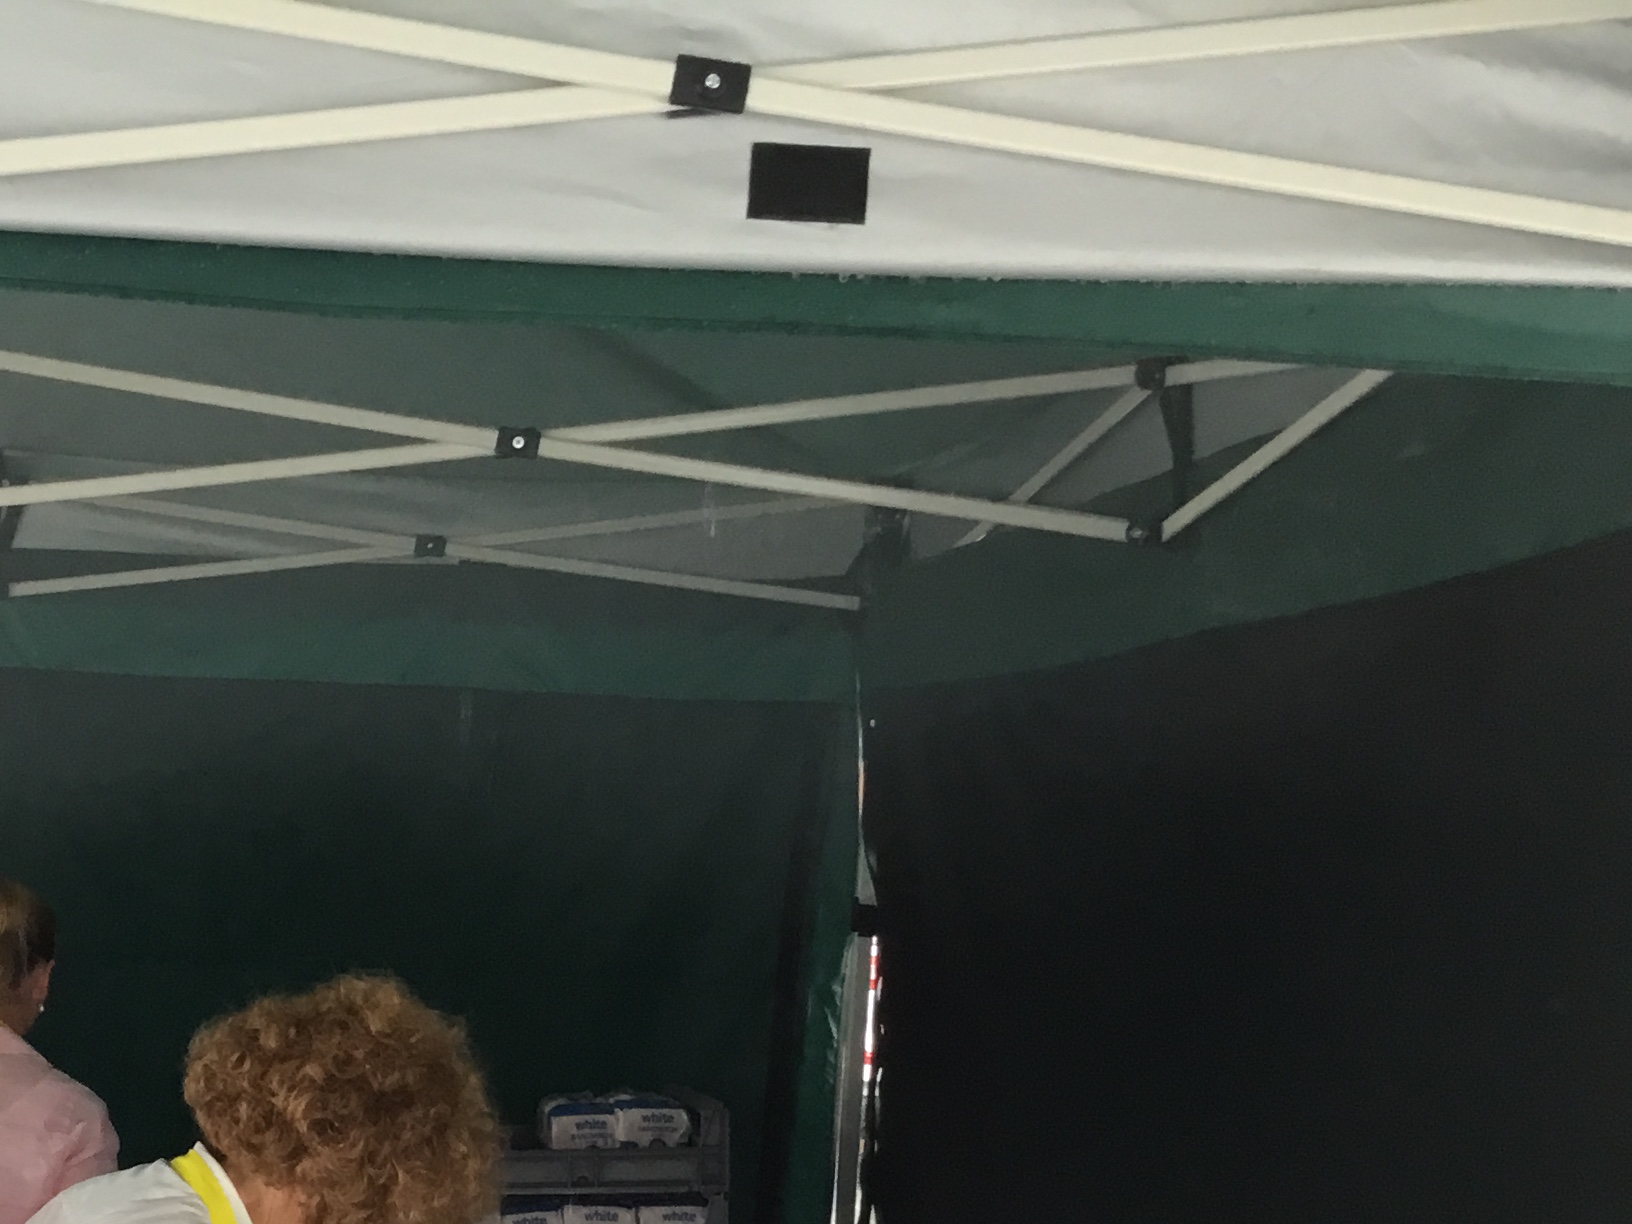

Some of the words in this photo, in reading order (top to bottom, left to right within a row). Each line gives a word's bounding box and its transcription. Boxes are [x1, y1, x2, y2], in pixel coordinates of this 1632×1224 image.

[641, 1111, 675, 1123] white
[584, 1210, 619, 1222] white
[662, 1210, 697, 1222] white
